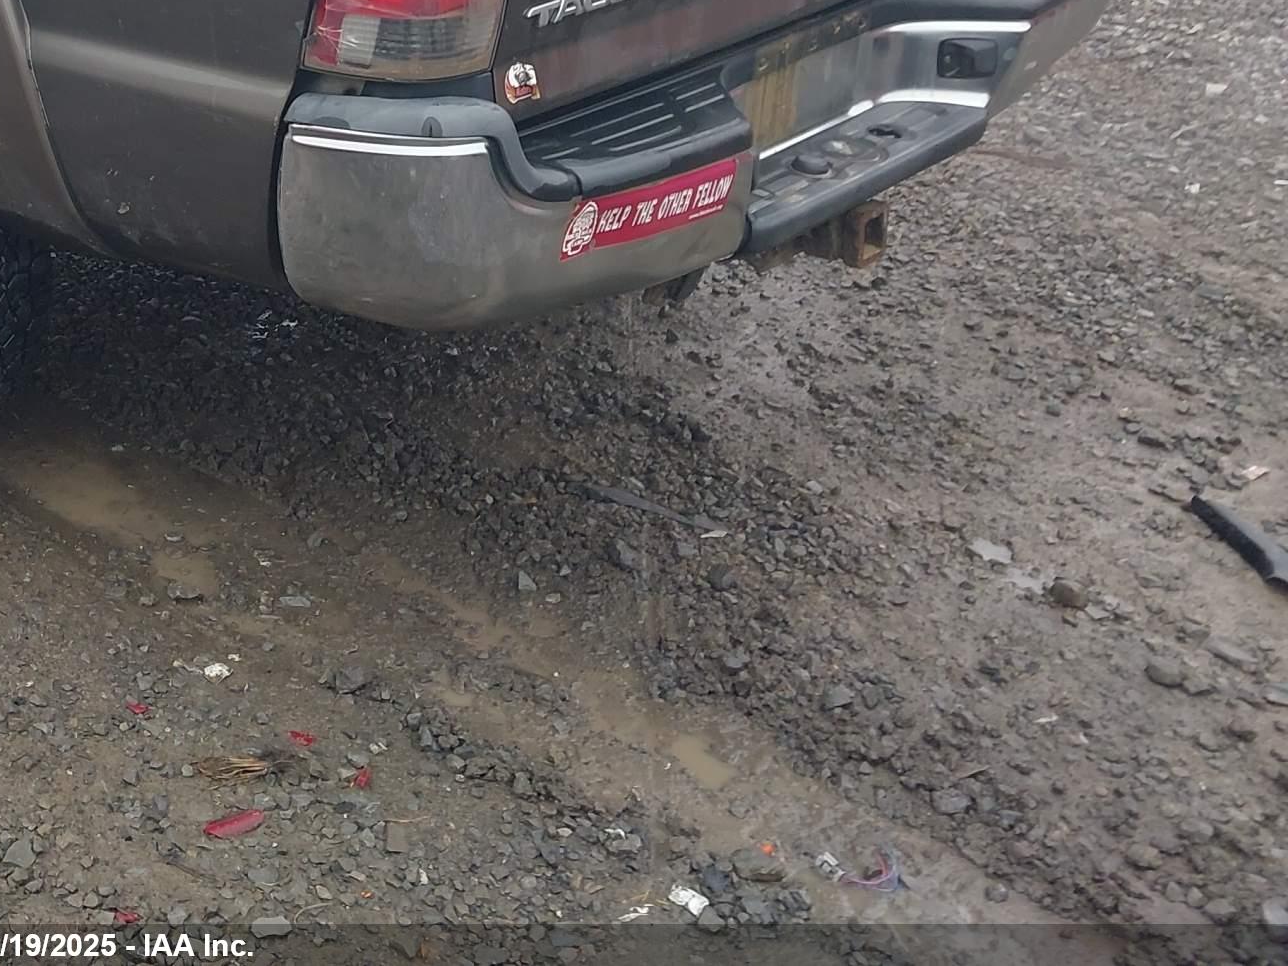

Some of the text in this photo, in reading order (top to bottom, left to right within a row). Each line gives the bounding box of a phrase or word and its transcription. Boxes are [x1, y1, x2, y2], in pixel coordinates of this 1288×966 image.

[596, 205, 631, 234] HELP
[632, 198, 658, 227] THE
[657, 187, 694, 220] OTHER
[692, 174, 734, 212] FELLOW
